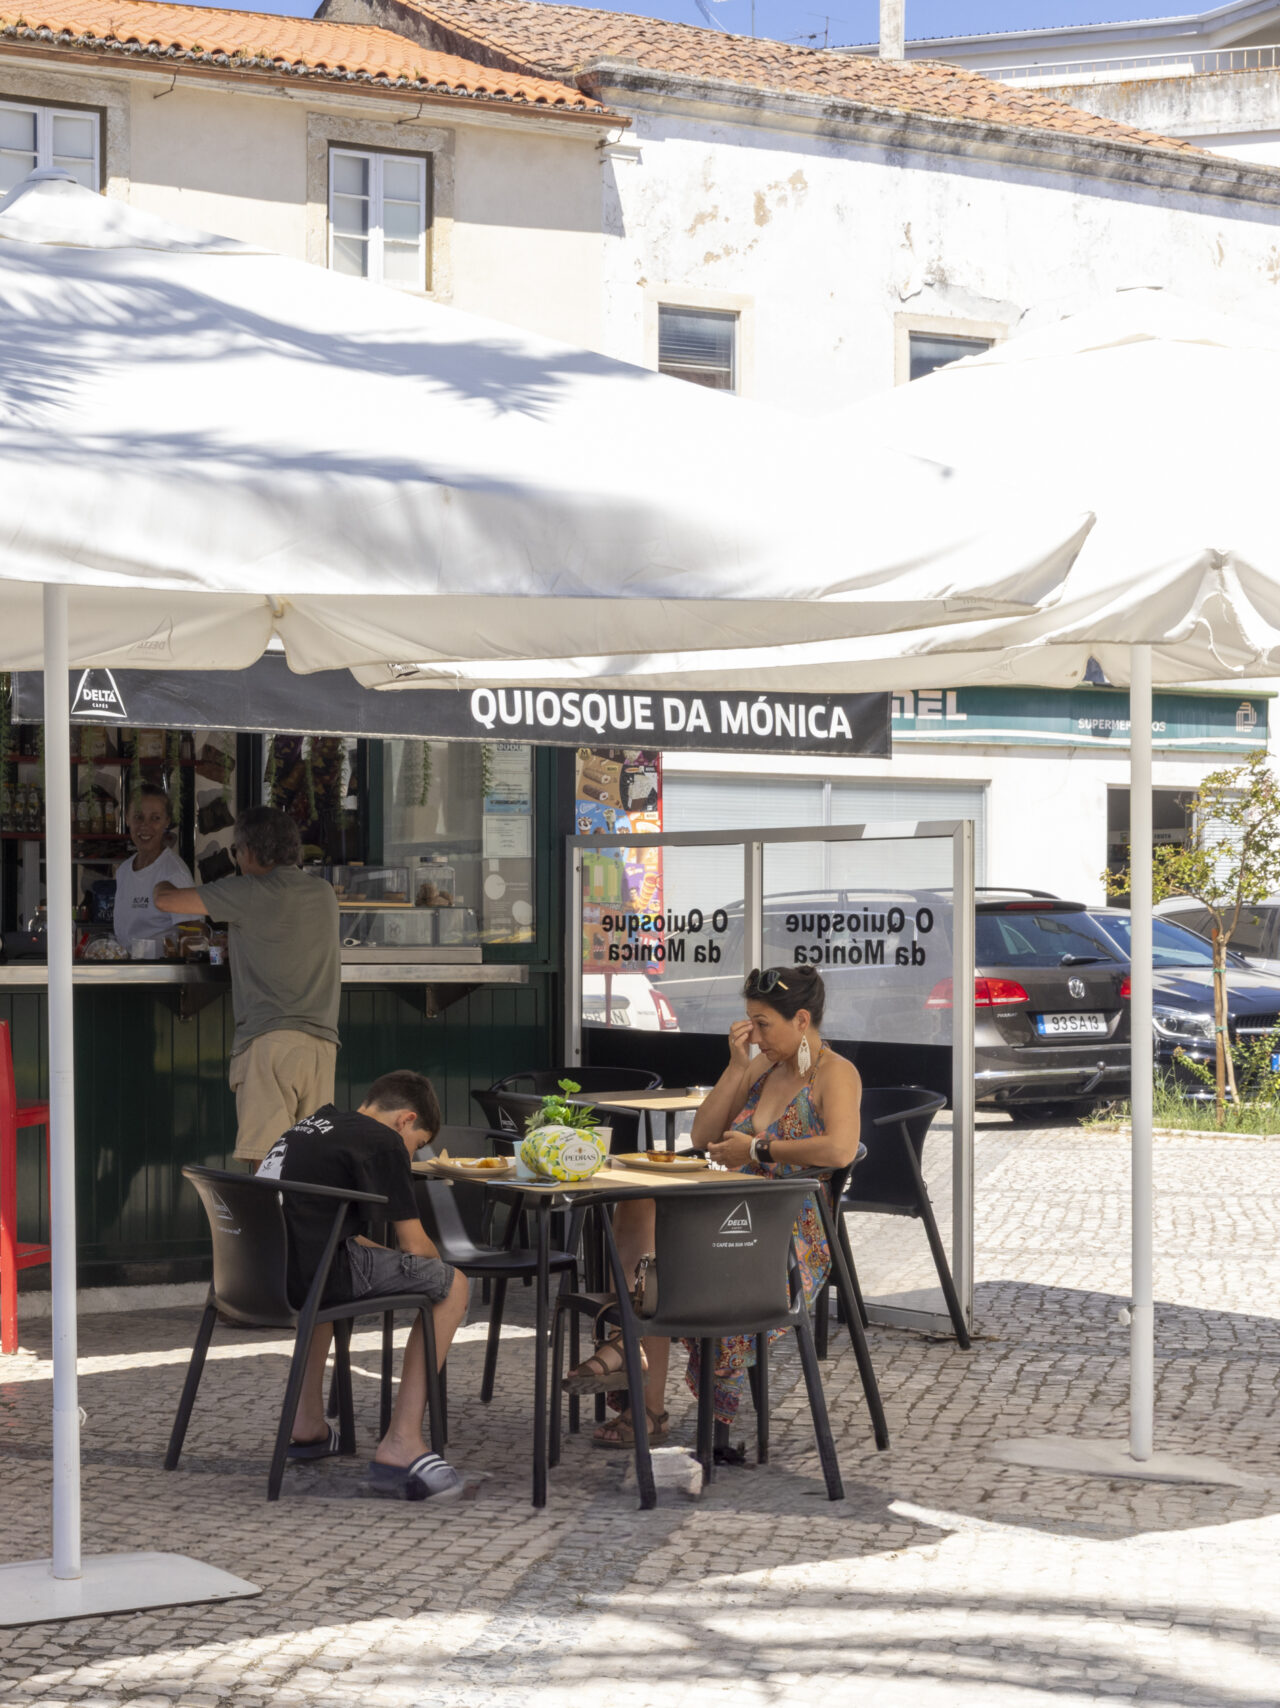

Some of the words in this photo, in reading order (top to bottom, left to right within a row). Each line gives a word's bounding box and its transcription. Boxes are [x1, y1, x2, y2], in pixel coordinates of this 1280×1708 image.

[470, 688, 654, 735] QUIOSQUE
[664, 697, 711, 733] DA
[720, 696, 853, 740] MÓNICA
[565, 1154, 596, 1162] PEDRAS
